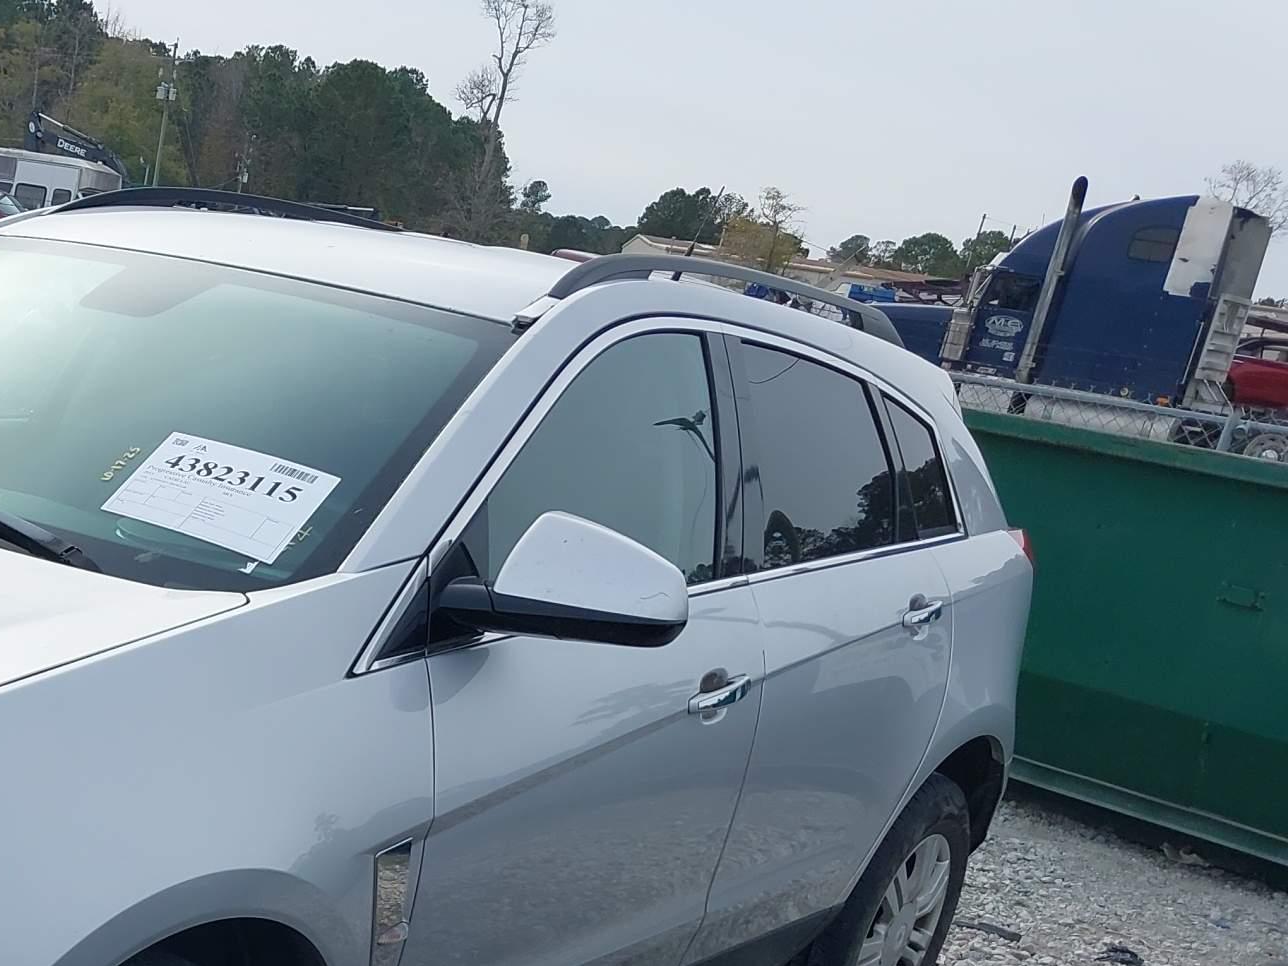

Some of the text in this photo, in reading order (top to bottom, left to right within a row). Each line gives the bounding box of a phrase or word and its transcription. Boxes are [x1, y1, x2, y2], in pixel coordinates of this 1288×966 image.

[57, 138, 87, 157] DEERE
[147, 465, 187, 479] Progressive
[187, 473, 217, 488] Casualty
[217, 482, 253, 497] Insurance
[164, 454, 303, 503] 43823115
